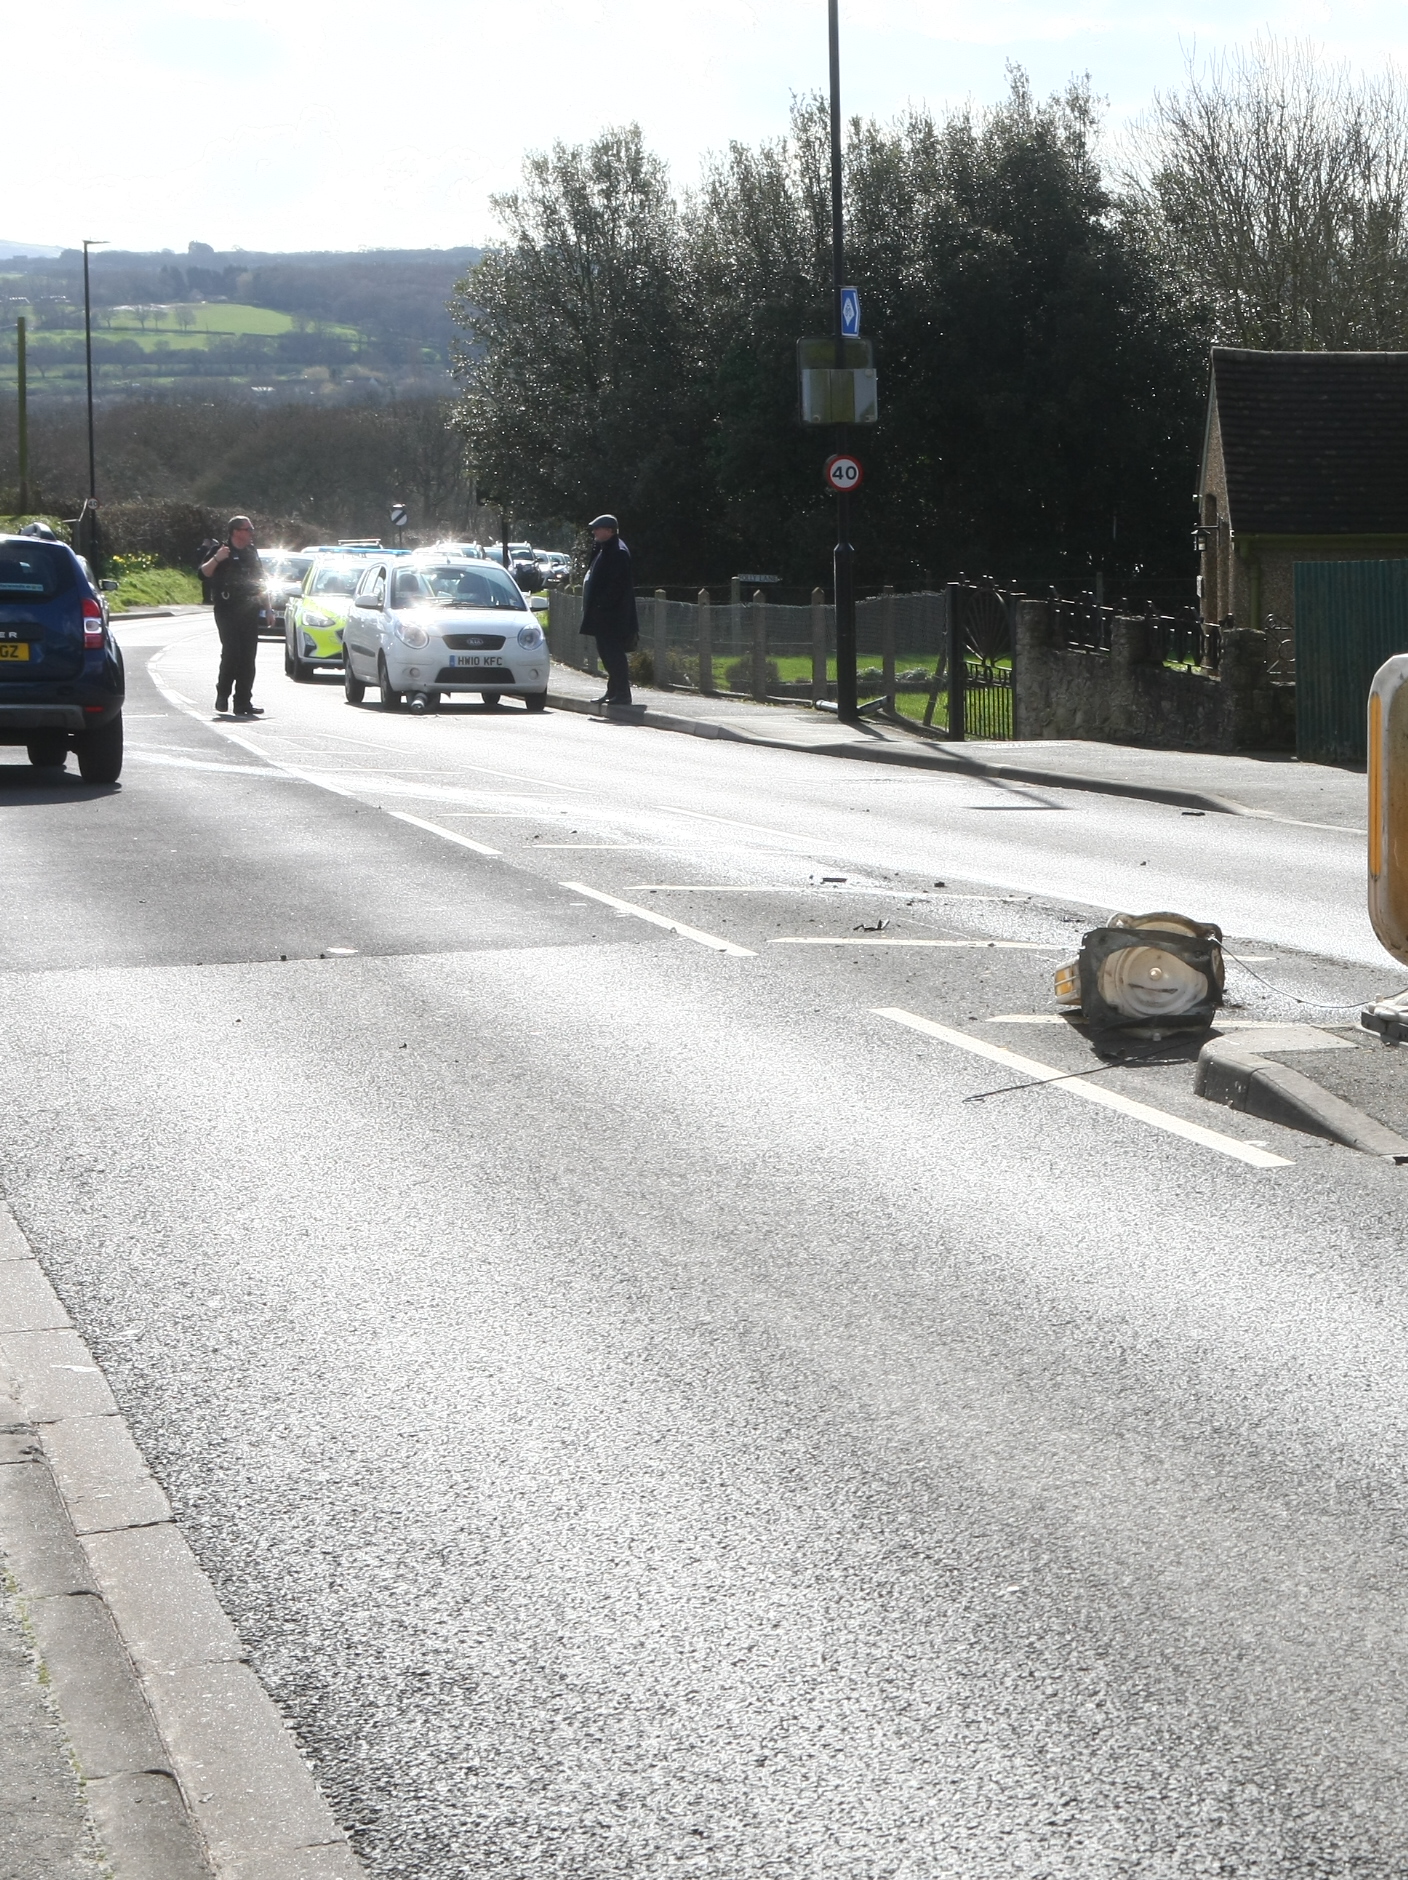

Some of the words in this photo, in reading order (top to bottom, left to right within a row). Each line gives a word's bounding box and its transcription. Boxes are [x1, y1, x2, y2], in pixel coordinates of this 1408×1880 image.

[832, 465, 857, 481] 40
[457, 656, 480, 666] HW10
[483, 656, 503, 666] KFC
